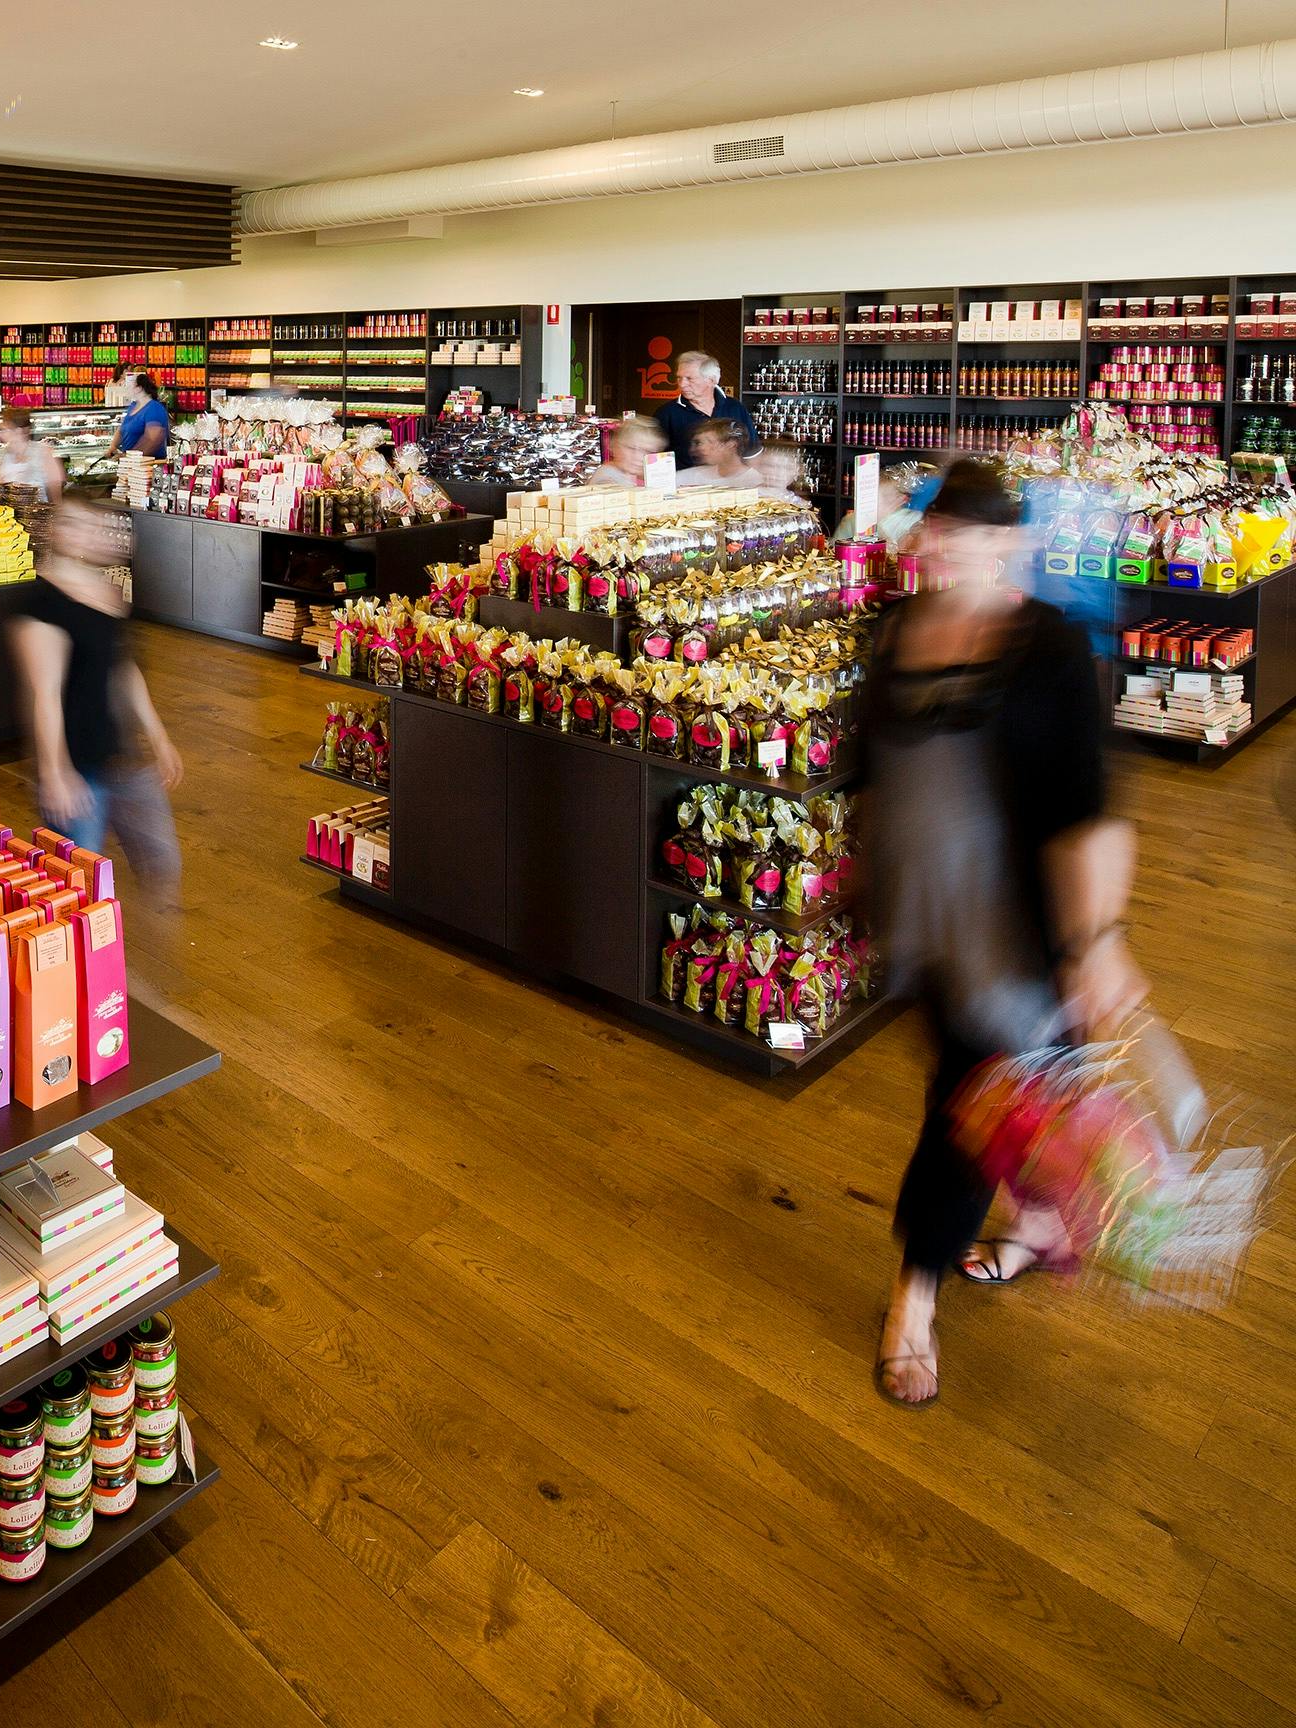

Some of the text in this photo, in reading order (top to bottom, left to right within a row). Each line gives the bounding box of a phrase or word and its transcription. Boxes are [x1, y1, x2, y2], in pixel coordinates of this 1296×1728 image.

[148, 1420, 172, 1430] Lollies
[13, 1457, 39, 1471] Lollies
[10, 1511, 37, 1523] Lollies
